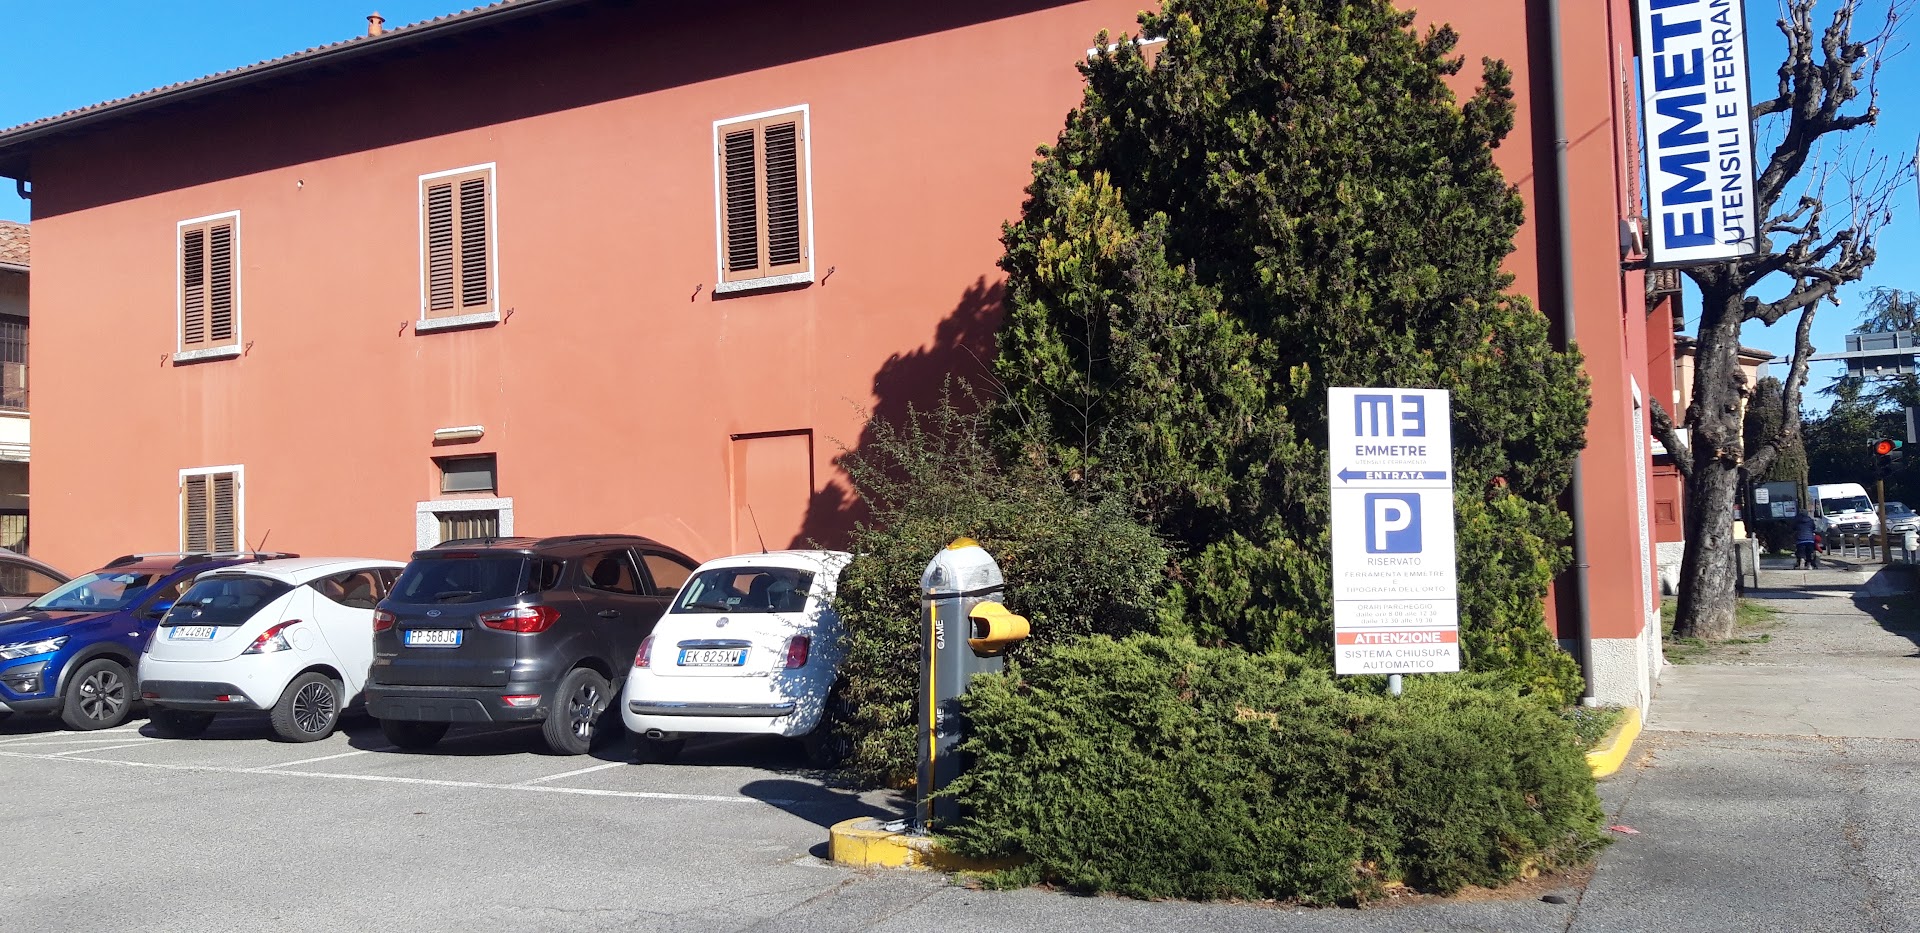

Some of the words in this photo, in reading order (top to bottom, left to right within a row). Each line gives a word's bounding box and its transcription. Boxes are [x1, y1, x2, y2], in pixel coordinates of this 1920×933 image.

[1716, 102, 1738, 119] E
[1650, 0, 1716, 250] EMMET
[1717, 127, 1745, 245] UTENSILI
[1355, 445, 1427, 456] EMMETRE
[1366, 471, 1425, 480] ENTRATA
[1374, 498, 1412, 551] P
[1367, 557, 1421, 566] RISERVATO
[1354, 631, 1441, 644] ATTENZIONE
[1345, 650, 1392, 658] SISTEMA
[1395, 648, 1451, 658] CHIUSURA
[1363, 660, 1434, 669] AUTOMATICO
